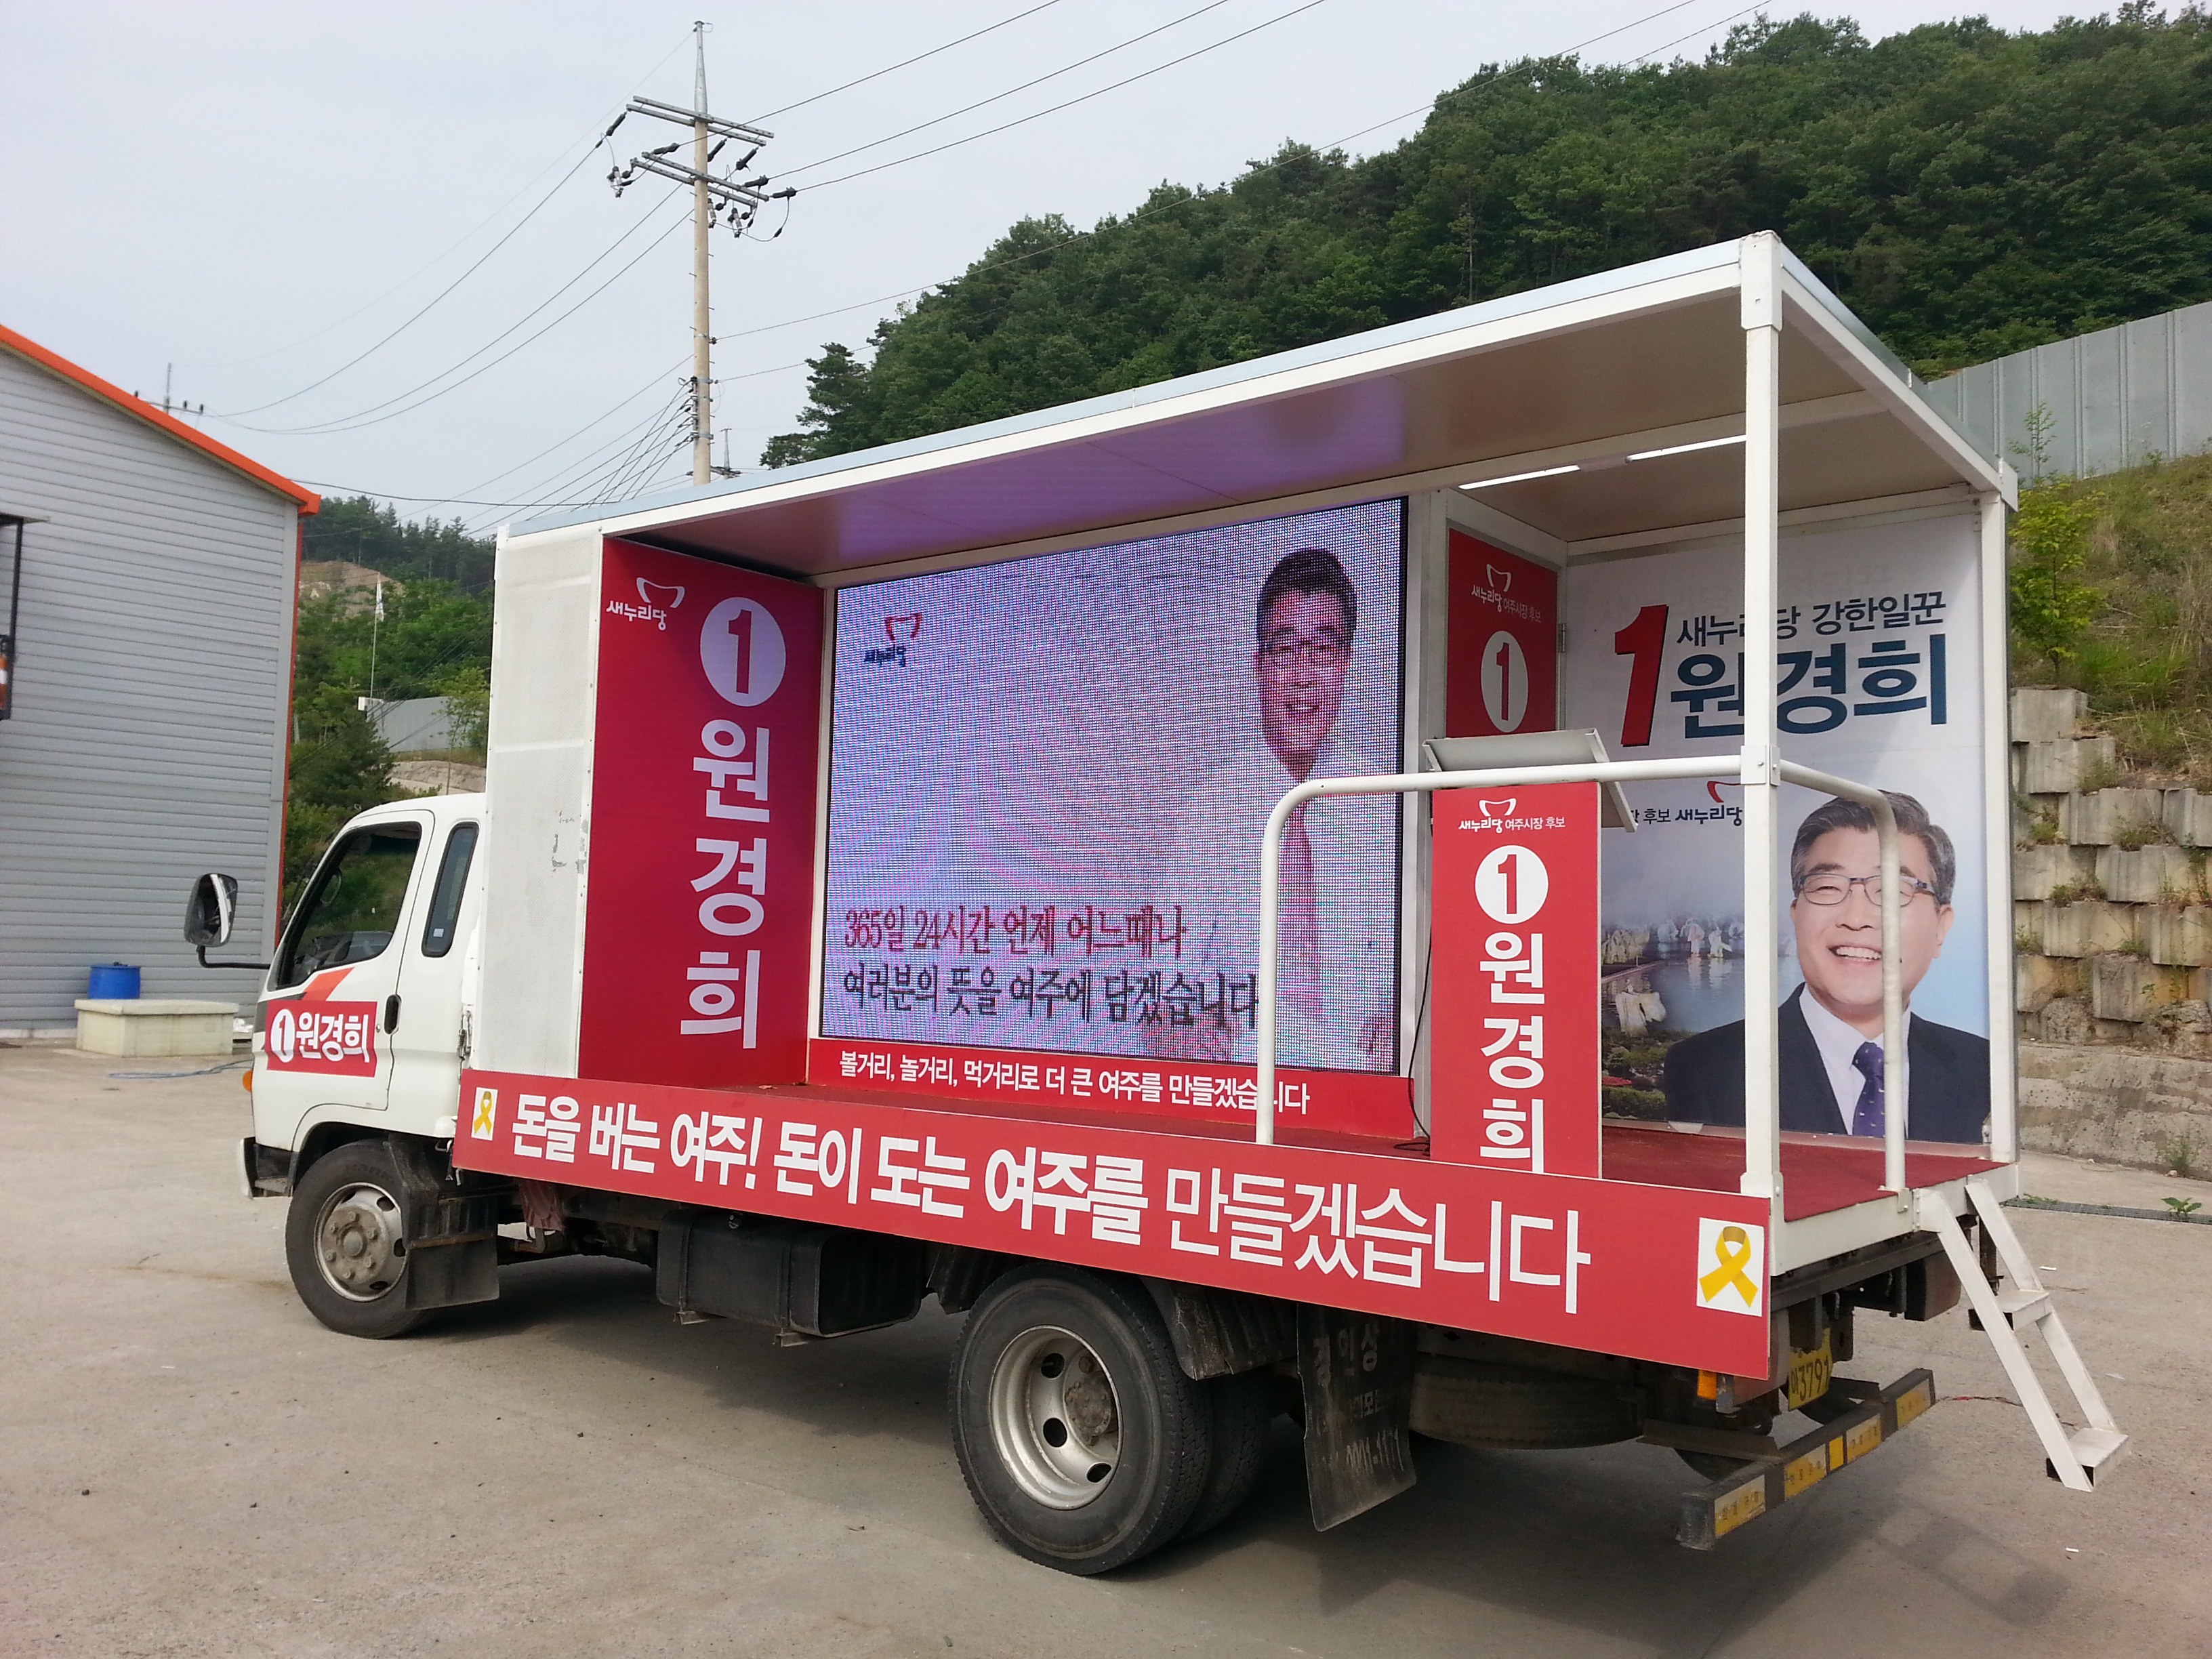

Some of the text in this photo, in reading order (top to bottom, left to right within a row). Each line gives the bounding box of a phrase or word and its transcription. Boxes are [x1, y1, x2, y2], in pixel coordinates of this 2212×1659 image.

[606, 600, 667, 630] 새누리당
[1471, 585, 1541, 623] 새누리당 여주시장 후보
[1677, 591, 1946, 647] 새누당 강한일꾼
[1615, 605, 1947, 747] 1 원경희
[1458, 817, 1565, 833] 새누리당 여주시장 후보
[1643, 808, 1671, 825] 후보
[1675, 805, 1742, 826] 새누리당
[680, 720, 770, 1048] 원경희
[845, 905, 905, 951] 365일
[914, 905, 996, 954] 24시간
[1004, 905, 1055, 956] 언제
[844, 962, 938, 1013] 여러분의
[947, 966, 1003, 1015] 뜻을
[1010, 968, 1090, 1023] 여주에
[296, 1012, 370, 1063] 원경희
[1479, 932, 1546, 1174] 원경희
[840, 1050, 895, 1082] 볼거리,
[900, 1055, 958, 1087] 놀거리,
[964, 1060, 1040, 1091] 먹거리로
[1046, 1066, 1065, 1095] 더
[1070, 1067, 1093, 1097] 큰
[1099, 1070, 1164, 1103] 여주를
[512, 1094, 1592, 1314] 돈을 버는 여주! 돈이 도는 여주를 만들겠습니다
